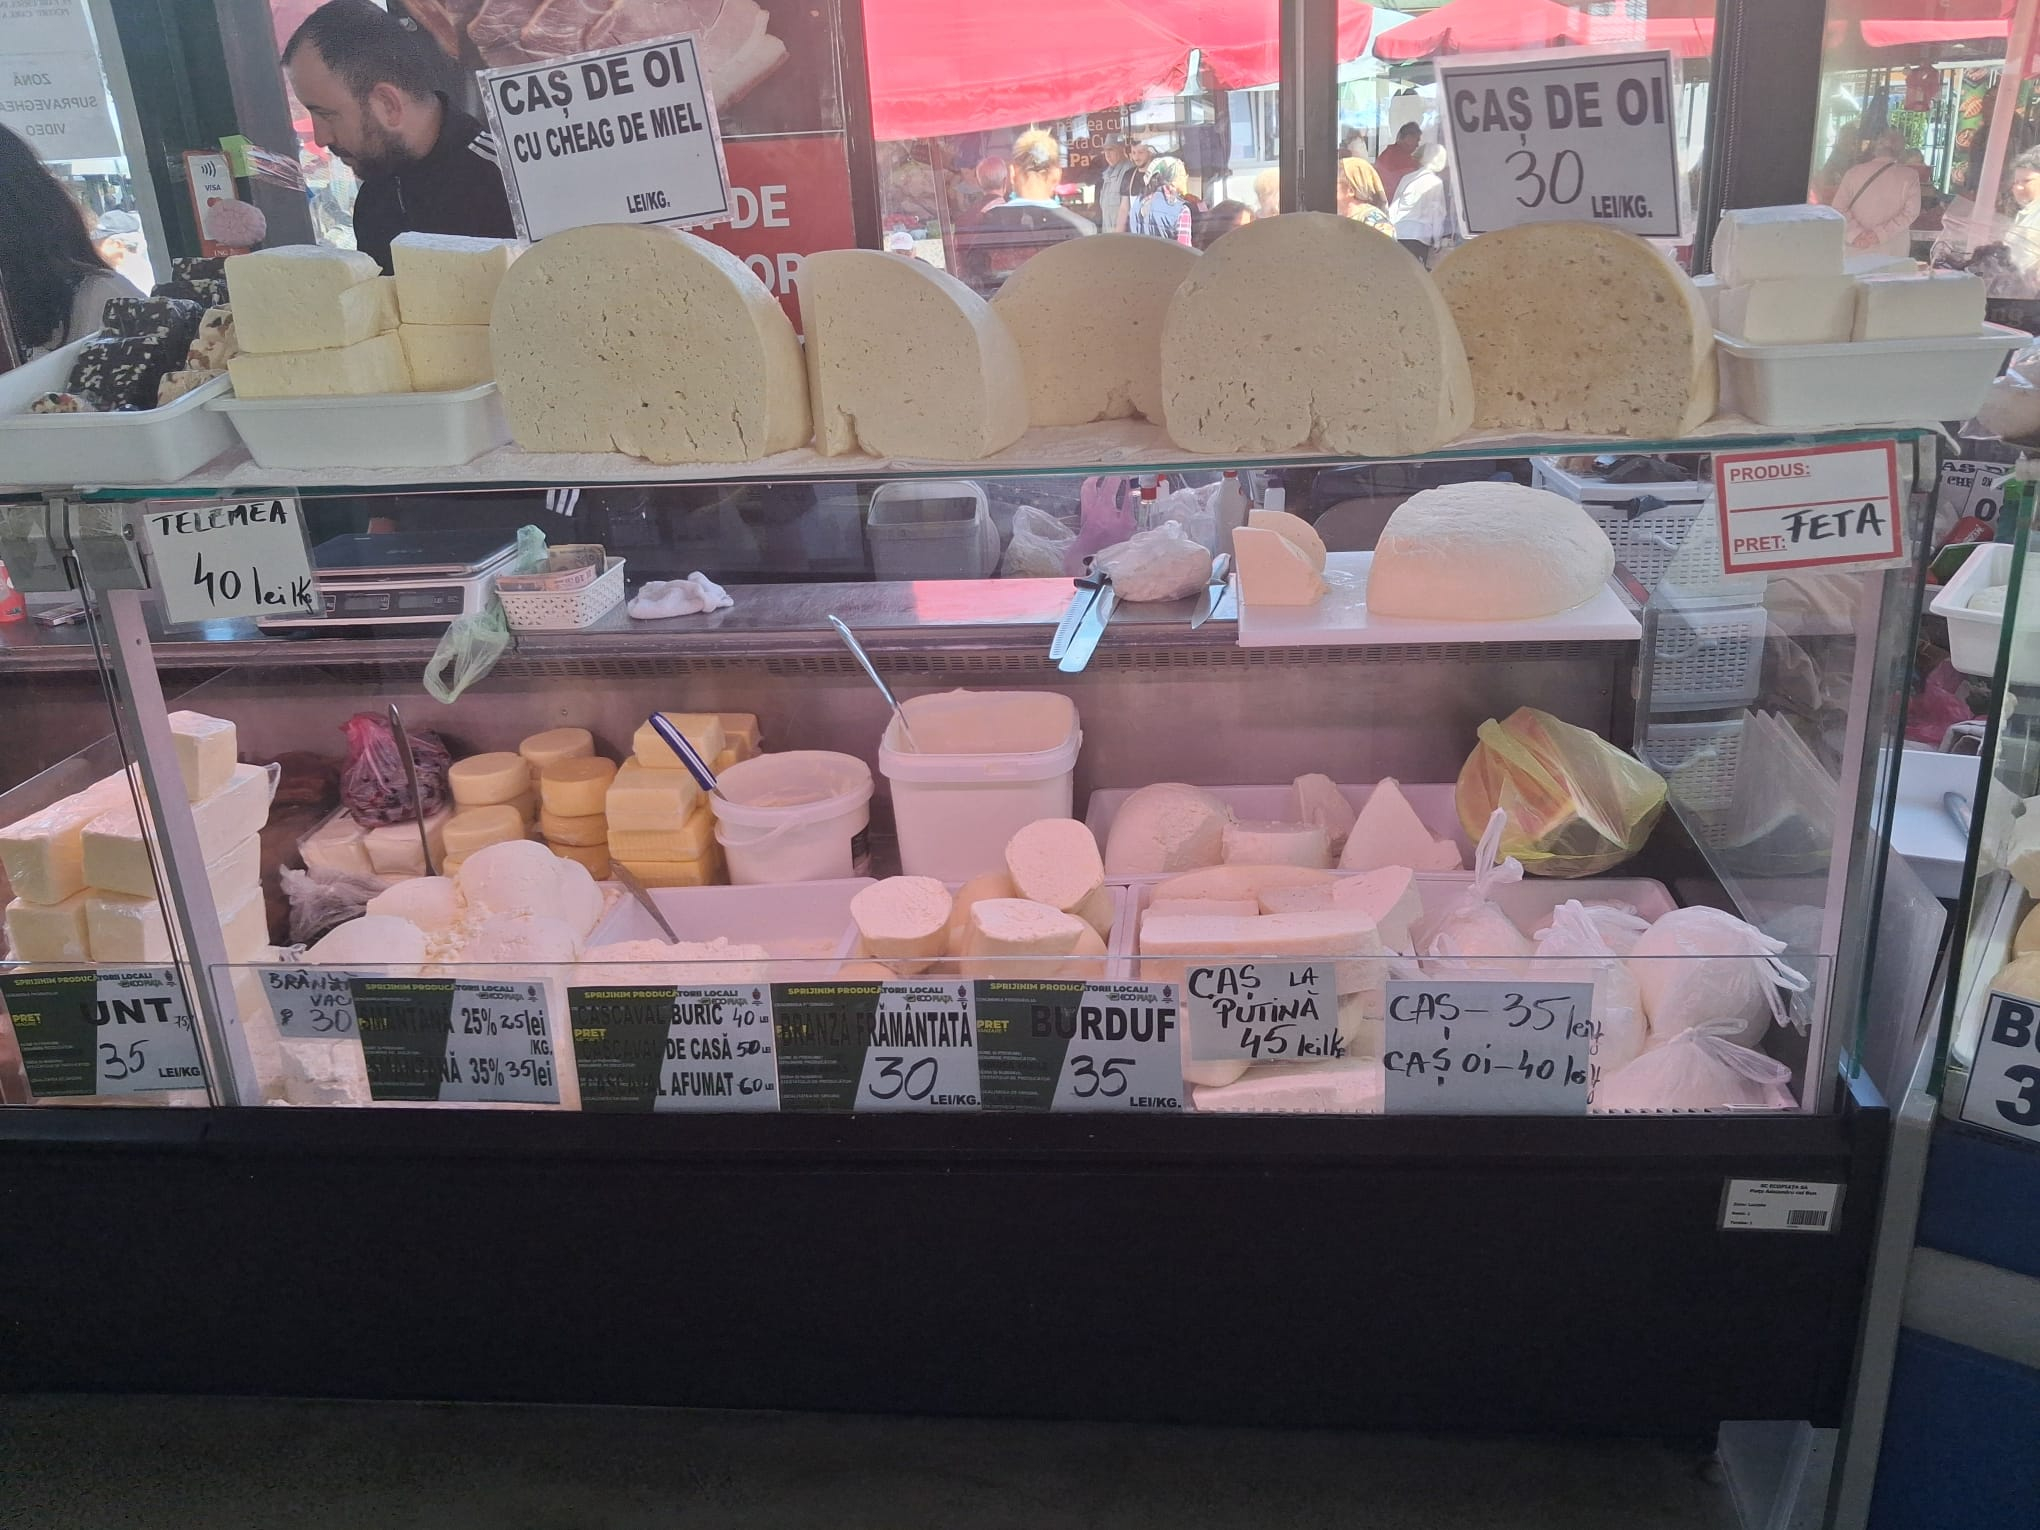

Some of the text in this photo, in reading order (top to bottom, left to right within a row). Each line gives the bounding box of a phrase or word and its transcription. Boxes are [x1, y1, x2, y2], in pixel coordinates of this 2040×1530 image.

[500, 47, 685, 118] CAȘ DE OI
[1454, 77, 1665, 146] CAȘ DE OI
[513, 103, 703, 163] CU CHEAG DE MIEL
[626, 190, 671, 214] LEI/KG.
[1505, 150, 1653, 219] 30 LEI/KG.
[729, 184, 790, 229] DE
[1730, 462, 1811, 482] PRODUS:
[152, 500, 288, 535] TELEMEA
[1734, 502, 1887, 552] PRET: FETA
[194, 552, 242, 607] 40
[121, 972, 153, 980] LOCALI
[481, 985, 515, 993] LOCALI
[788, 988, 836, 996] SPRIJINIM
[990, 983, 1038, 991] SPRIJINIM
[1113, 985, 1149, 993] LOCALI
[1188, 964, 1320, 1000] CAȘ LA
[80, 997, 173, 1026] UNT
[584, 991, 631, 999] SPRIJINIM
[310, 1009, 352, 1032] 30
[461, 1007, 498, 1036] 25%
[500, 1013, 525, 1031] 25
[525, 1009, 547, 1036] lei
[672, 1003, 723, 1026] BURIC
[732, 1008, 755, 1028] 40
[760, 1015, 769, 1023] LEI
[1031, 1004, 1176, 1042] BURDUF
[1389, 993, 1460, 1040] CAȘ
[1503, 993, 1572, 1031] 35
[1991, 999, 2040, 1054] B
[666, 1037, 687, 1060] DE
[690, 1033, 733, 1060] CASĂ
[762, 1046, 771, 1054] LEI
[1240, 1023, 1297, 1058] 45
[99, 1039, 150, 1080] 35
[468, 1057, 505, 1086] 35%
[505, 1060, 531, 1078] 35
[531, 1060, 553, 1087] lei
[1070, 1054, 1136, 1098] 35
[1383, 1047, 1451, 1087] CAȘ
[671, 1072, 733, 1096] AFUMAT
[739, 1077, 762, 1095] 60
[765, 1083, 774, 1091] LEI
[868, 1056, 938, 1101] 30
[930, 1094, 981, 1106] LEI/KG.
[1130, 1096, 1182, 1108] LEI/KG.
